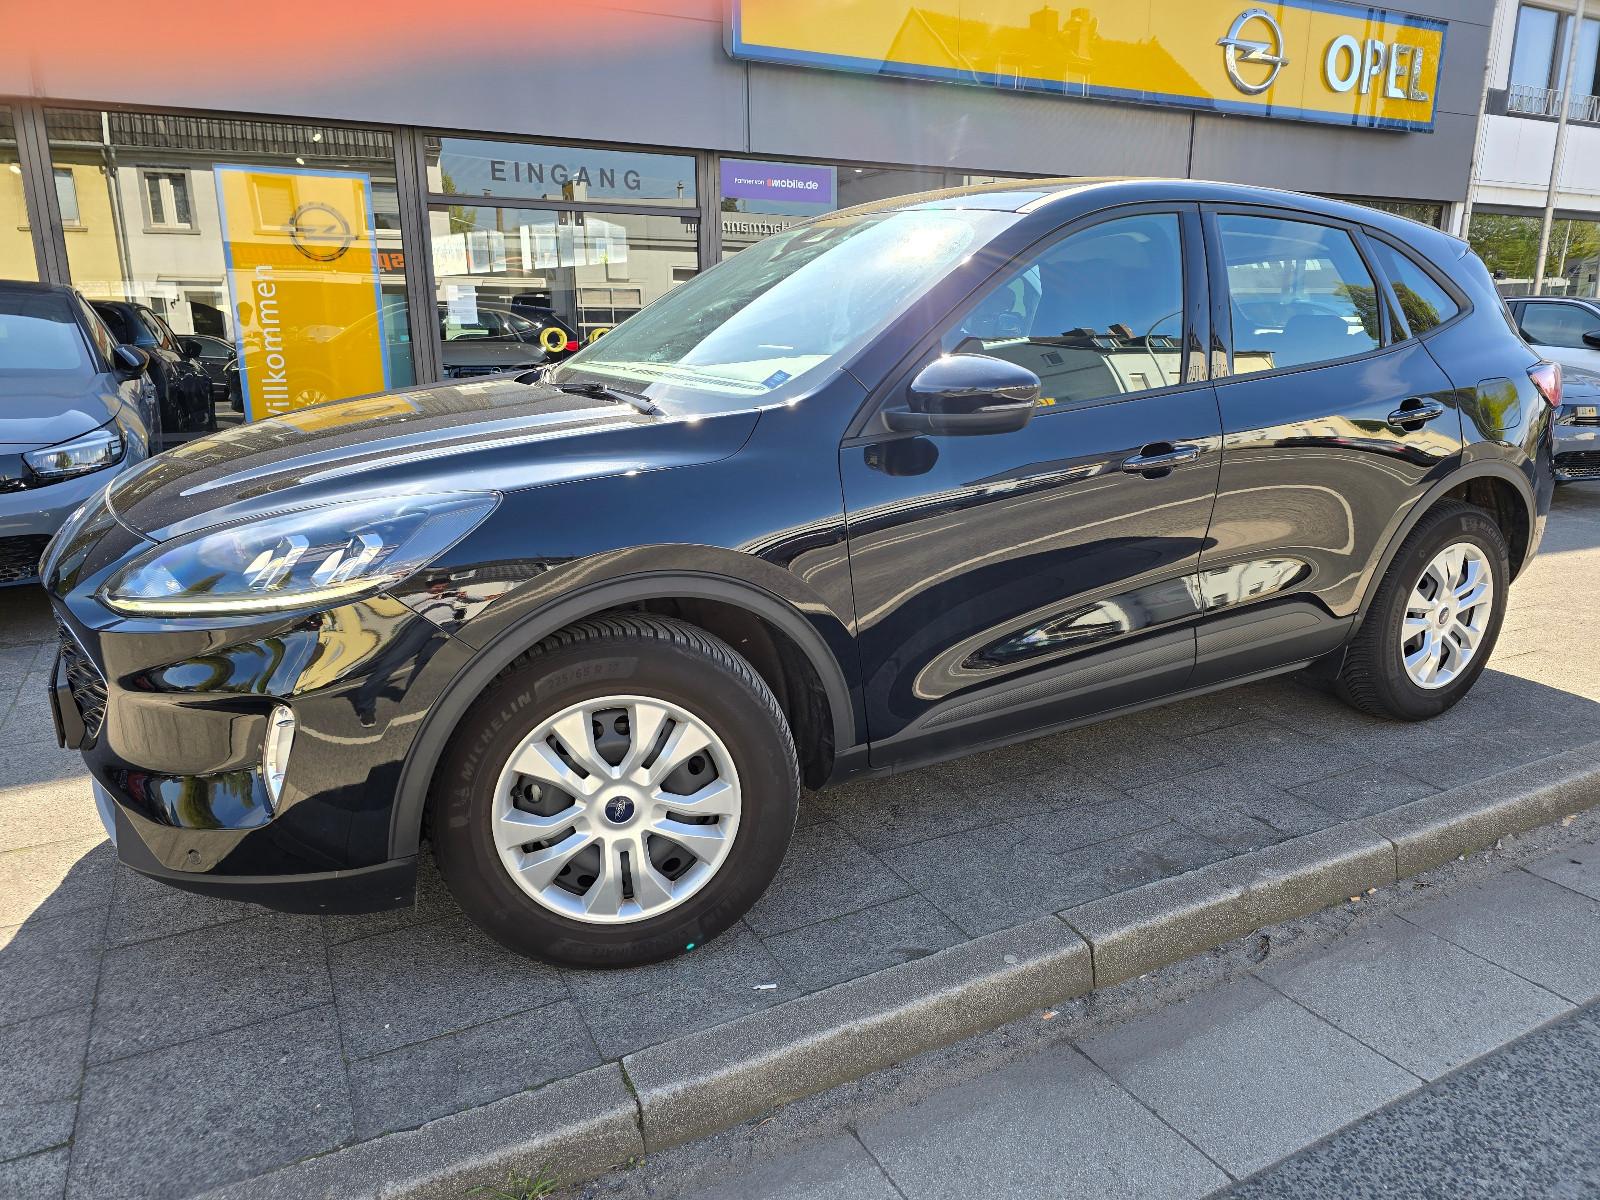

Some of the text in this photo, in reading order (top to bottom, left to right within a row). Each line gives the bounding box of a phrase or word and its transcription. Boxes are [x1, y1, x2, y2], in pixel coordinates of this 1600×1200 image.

[1325, 34, 1428, 102] OPEL
[490, 160, 641, 190] EINGANG
[768, 178, 819, 190] mobile.de
[461, 690, 533, 782] MICHELIN
